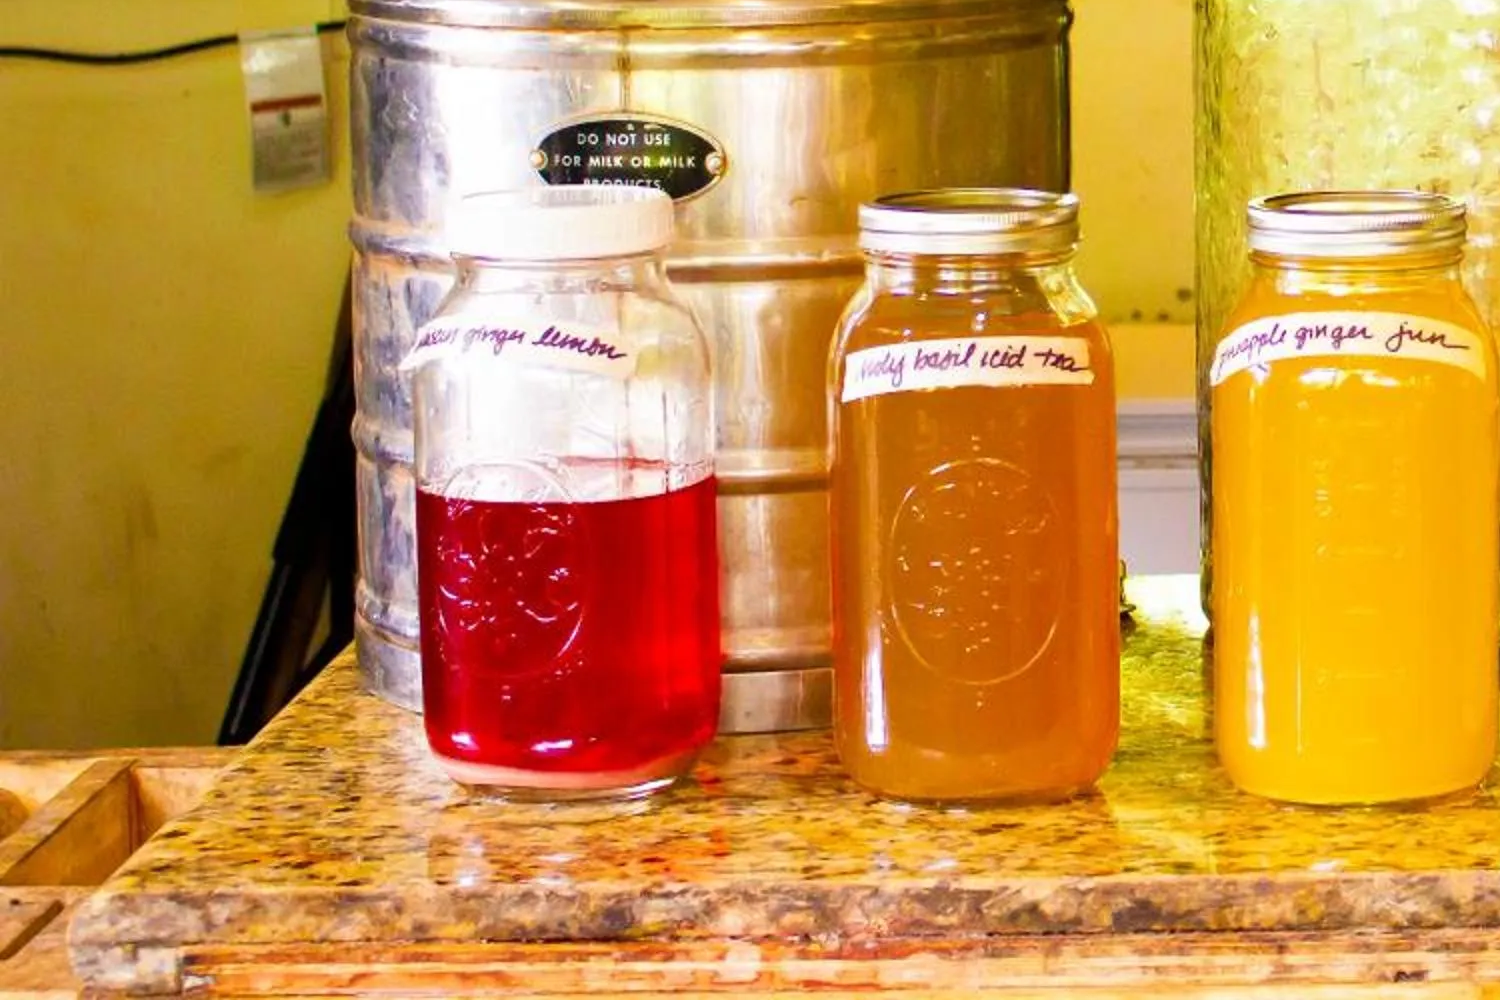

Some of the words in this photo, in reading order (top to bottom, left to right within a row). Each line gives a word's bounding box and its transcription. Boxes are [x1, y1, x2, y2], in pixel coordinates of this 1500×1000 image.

[577, 134, 598, 146] DO
[606, 133, 637, 146] NOT
[644, 133, 671, 146] USE
[554, 156, 581, 167] FOR
[589, 156, 623, 168] MILK
[631, 156, 651, 168] OR
[659, 156, 696, 168] MILK
[532, 325, 627, 359] lemon
[1295, 324, 1373, 350] ginger
[913, 342, 977, 371] basil
